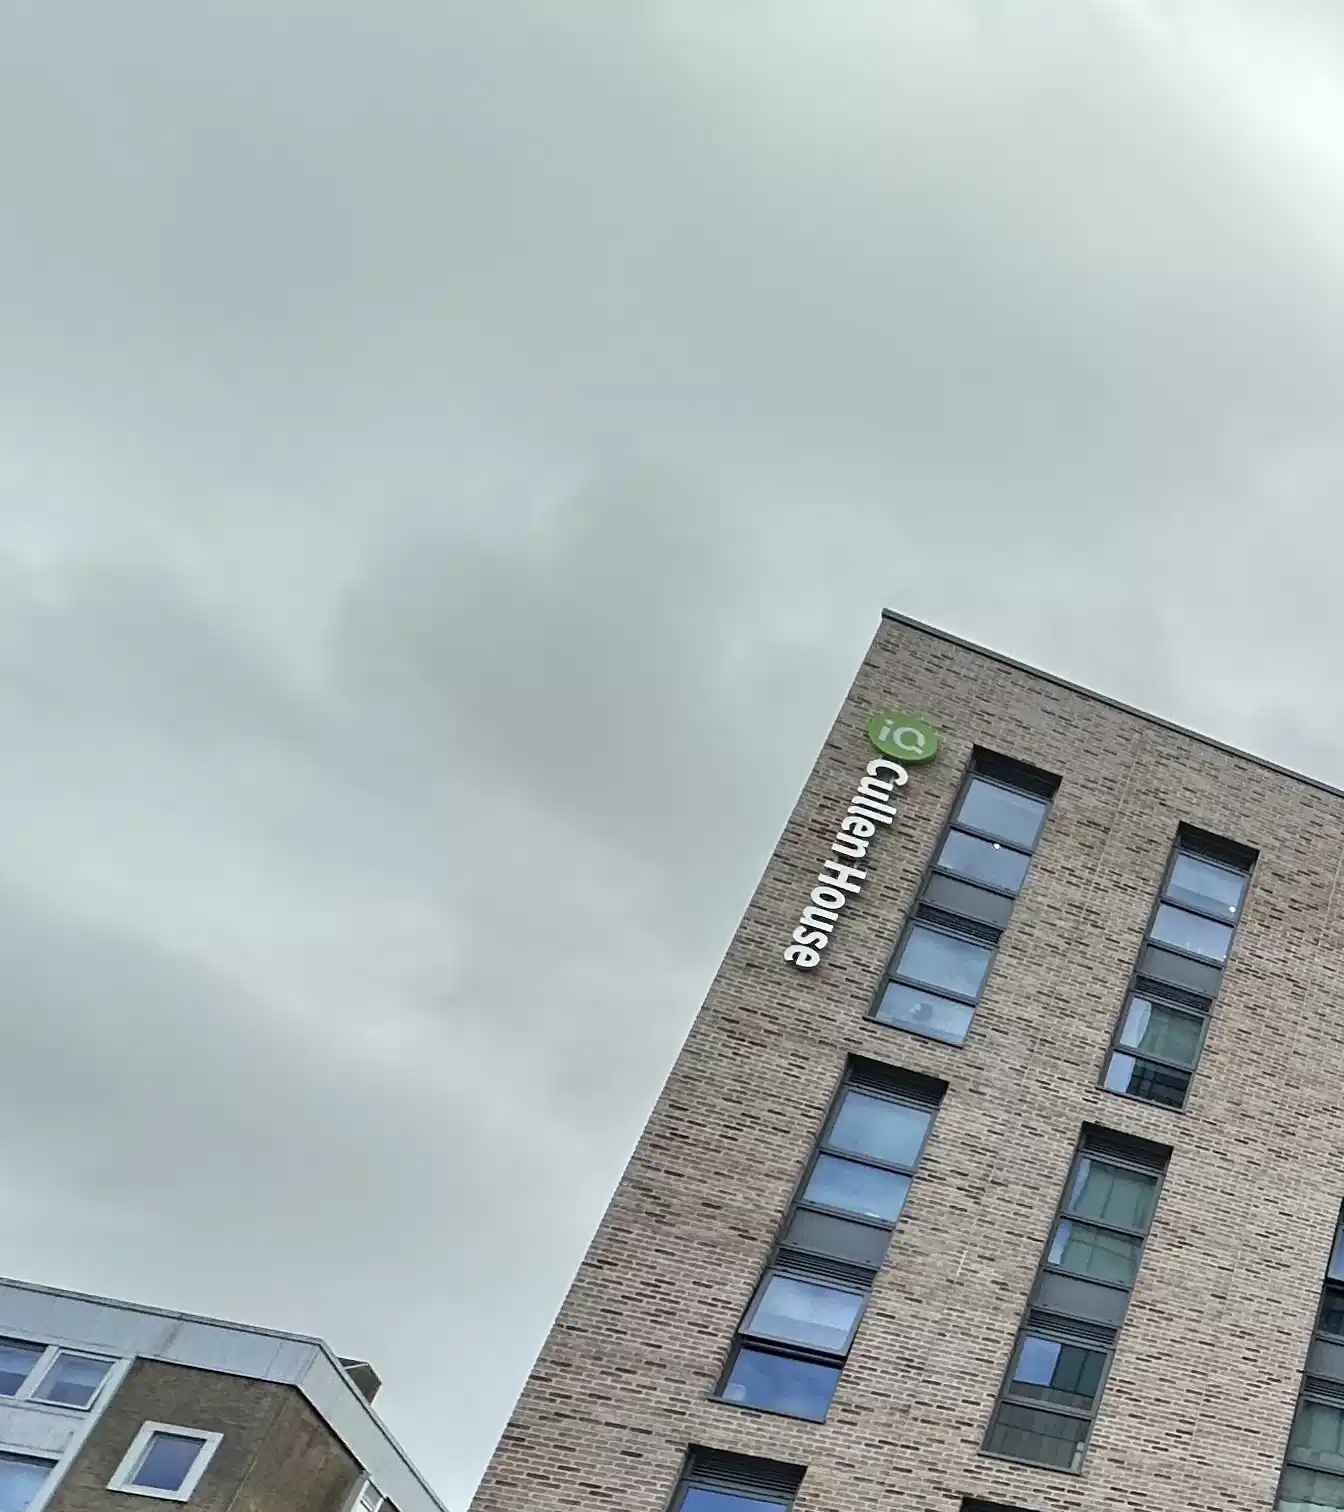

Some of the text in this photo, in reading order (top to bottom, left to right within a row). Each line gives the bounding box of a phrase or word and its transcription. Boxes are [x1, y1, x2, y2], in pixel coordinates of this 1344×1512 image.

[878, 718, 925, 756] iQ
[783, 758, 909, 969] Cullen House
